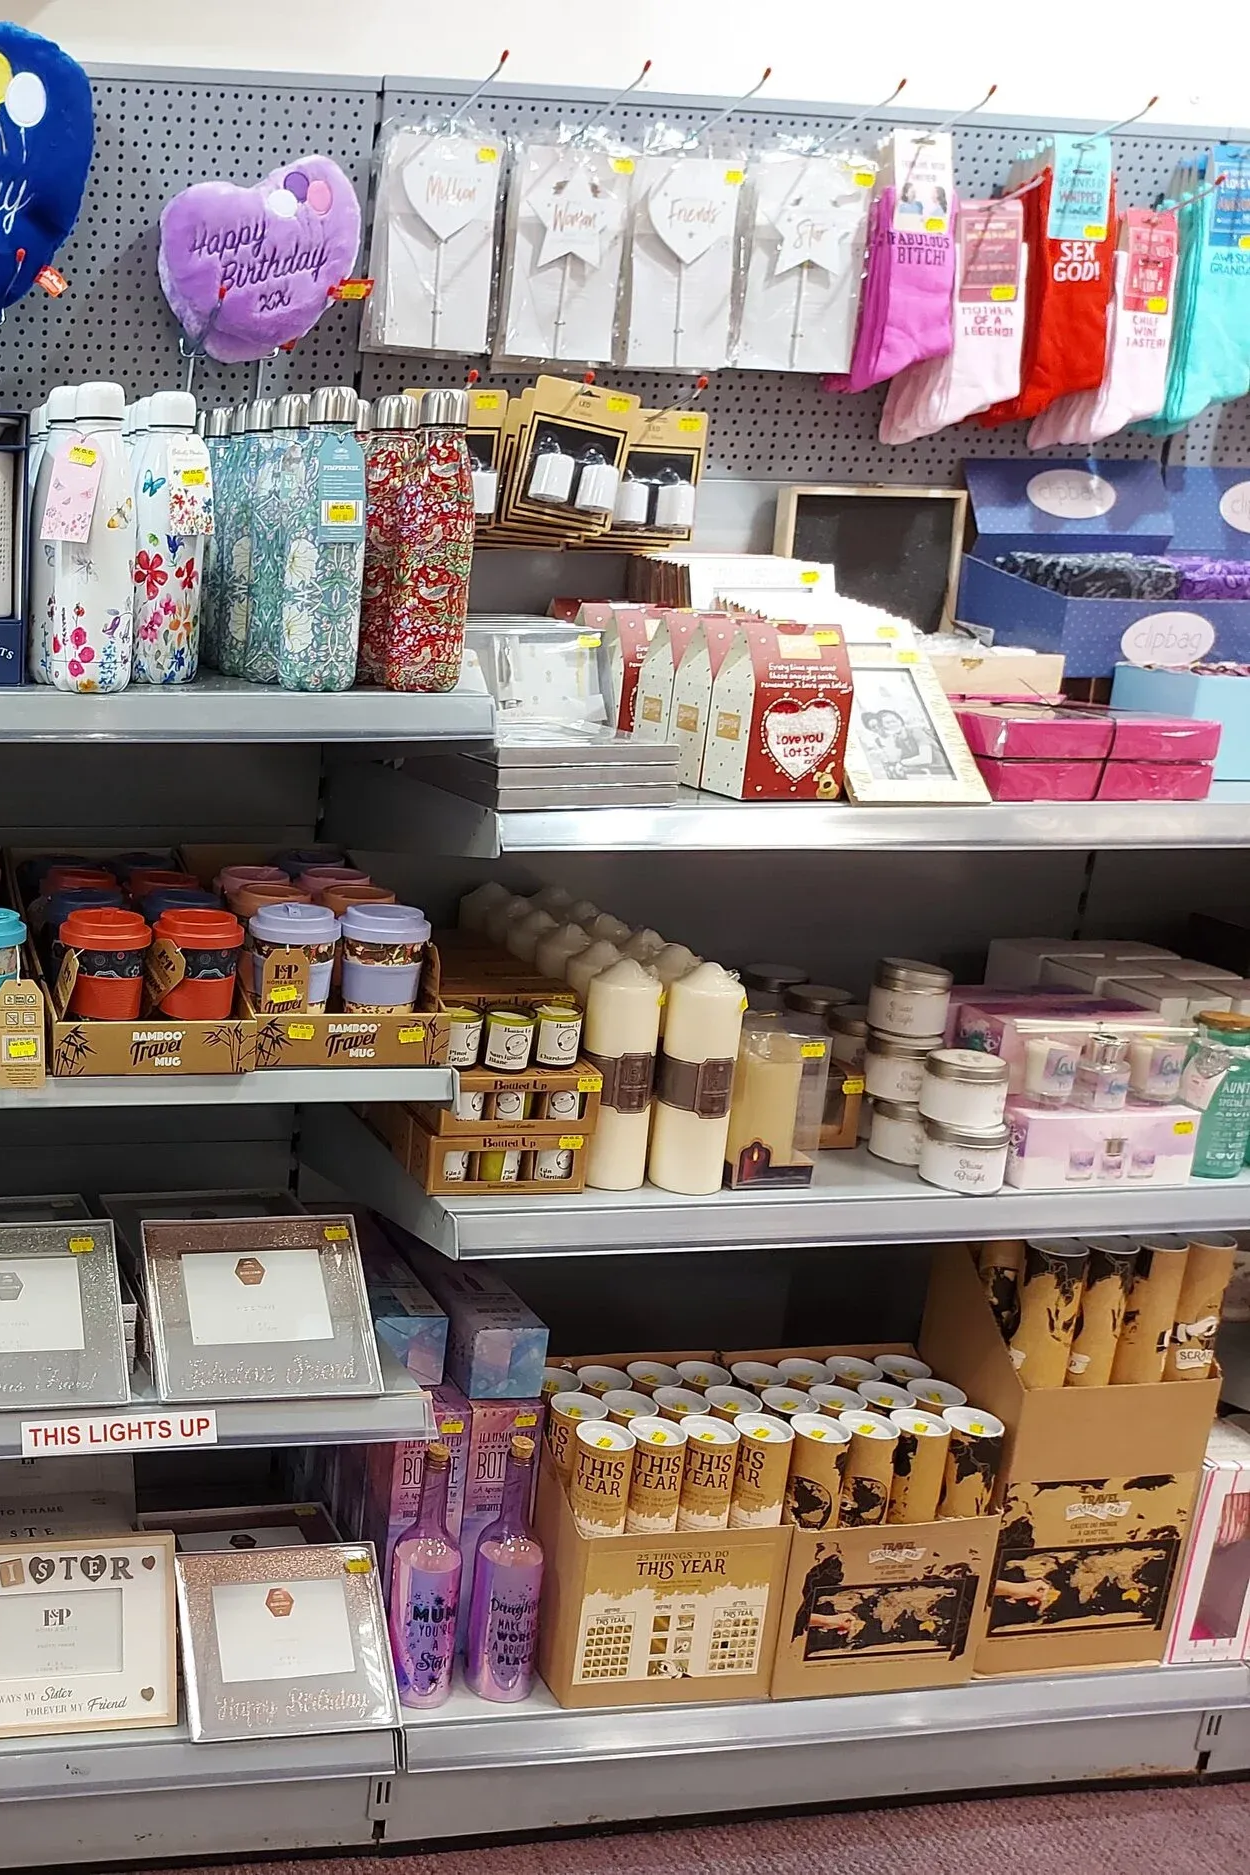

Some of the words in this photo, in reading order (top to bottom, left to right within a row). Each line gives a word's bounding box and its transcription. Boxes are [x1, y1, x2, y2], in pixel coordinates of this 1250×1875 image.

[667, 198, 721, 229] Friends
[188, 222, 267, 258] Happy
[896, 246, 946, 266] BITCH!
[1060, 241, 1097, 262] SEX
[220, 243, 329, 291] Birthday
[1053, 262, 1101, 282] GOD!
[258, 290, 292, 313] xx
[963, 326, 1014, 337] LEGEND!
[1134, 625, 1202, 656] clipbag
[802, 732, 824, 743] YOU
[130, 1039, 182, 1067] Travel
[325, 1032, 377, 1058] Travel
[349, 1048, 377, 1058] MUG
[154, 1056, 182, 1068] MUG
[494, 1080, 530, 1090] Bottled
[532, 1079, 548, 1091] Up
[482, 1137, 519, 1148] Bottled
[521, 1137, 536, 1148] Up
[36, 1366, 99, 1393] Friend
[28, 1427, 81, 1448] THIS
[88, 1421, 172, 1445] LIGHTS
[180, 1418, 211, 1440] UP
[578, 1450, 625, 1480] THIS
[635, 1449, 681, 1475] THIS
[686, 1448, 733, 1475] THIS
[576, 1473, 622, 1498] YEAR
[633, 1467, 678, 1492] YEAR
[684, 1465, 729, 1491] YEAR
[1081, 1492, 1120, 1506] TRAVEL
[1107, 1505, 1124, 1514] MAP
[21, 1505, 65, 1516] FRAME
[653, 1551, 693, 1561] THINGS
[697, 1551, 711, 1559] TO
[714, 1550, 730, 1558] DO
[881, 1541, 917, 1551] TRAVEL
[636, 1560, 675, 1580] THIS
[681, 1558, 727, 1576] YEAR
[432, 1640, 439, 1651] A
[23, 1691, 37, 1703] MY
[40, 1686, 74, 1702] Sister
[285, 1686, 370, 1718] Birthday
[25, 1704, 68, 1717] FOREVER
[70, 1702, 84, 1713] MY
[86, 1695, 129, 1713] Friend
